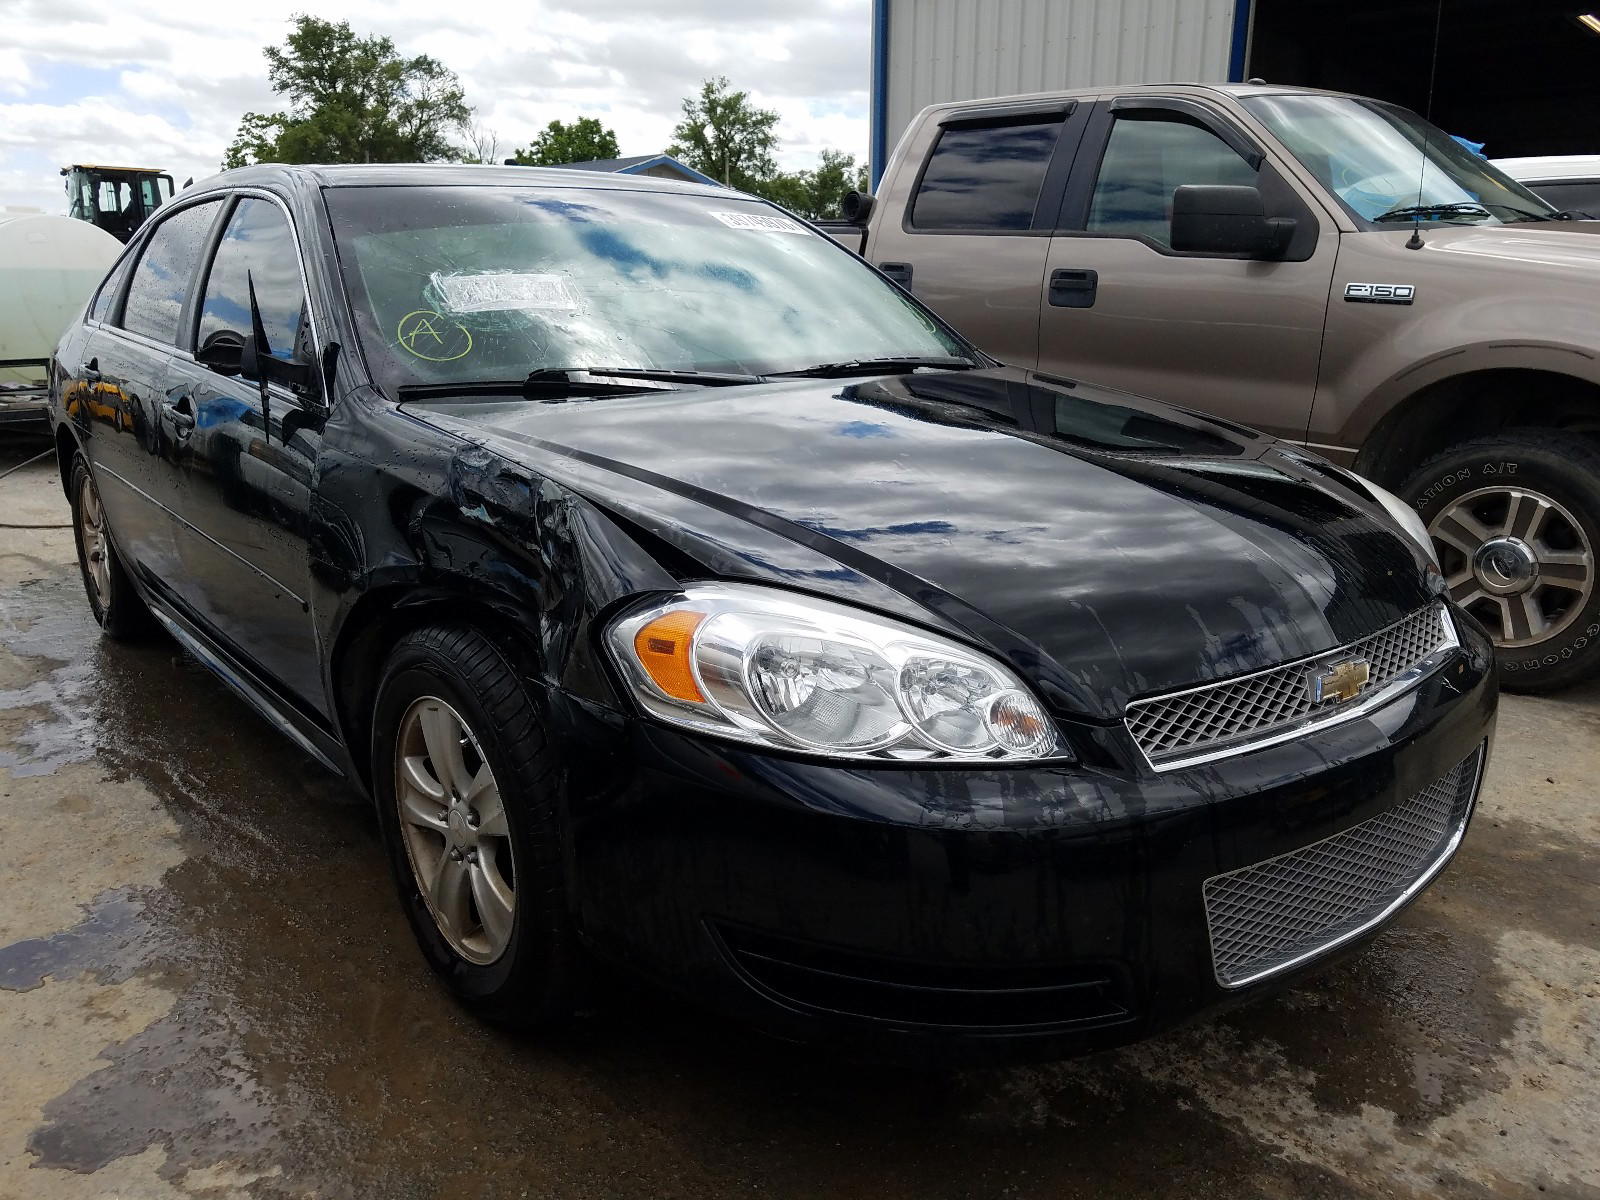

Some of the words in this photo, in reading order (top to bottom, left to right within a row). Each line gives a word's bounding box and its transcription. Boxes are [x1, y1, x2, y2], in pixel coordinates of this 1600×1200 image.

[1346, 285, 1412, 297] F-150
[409, 318, 444, 347] A
[1482, 462, 1518, 474] A/T
